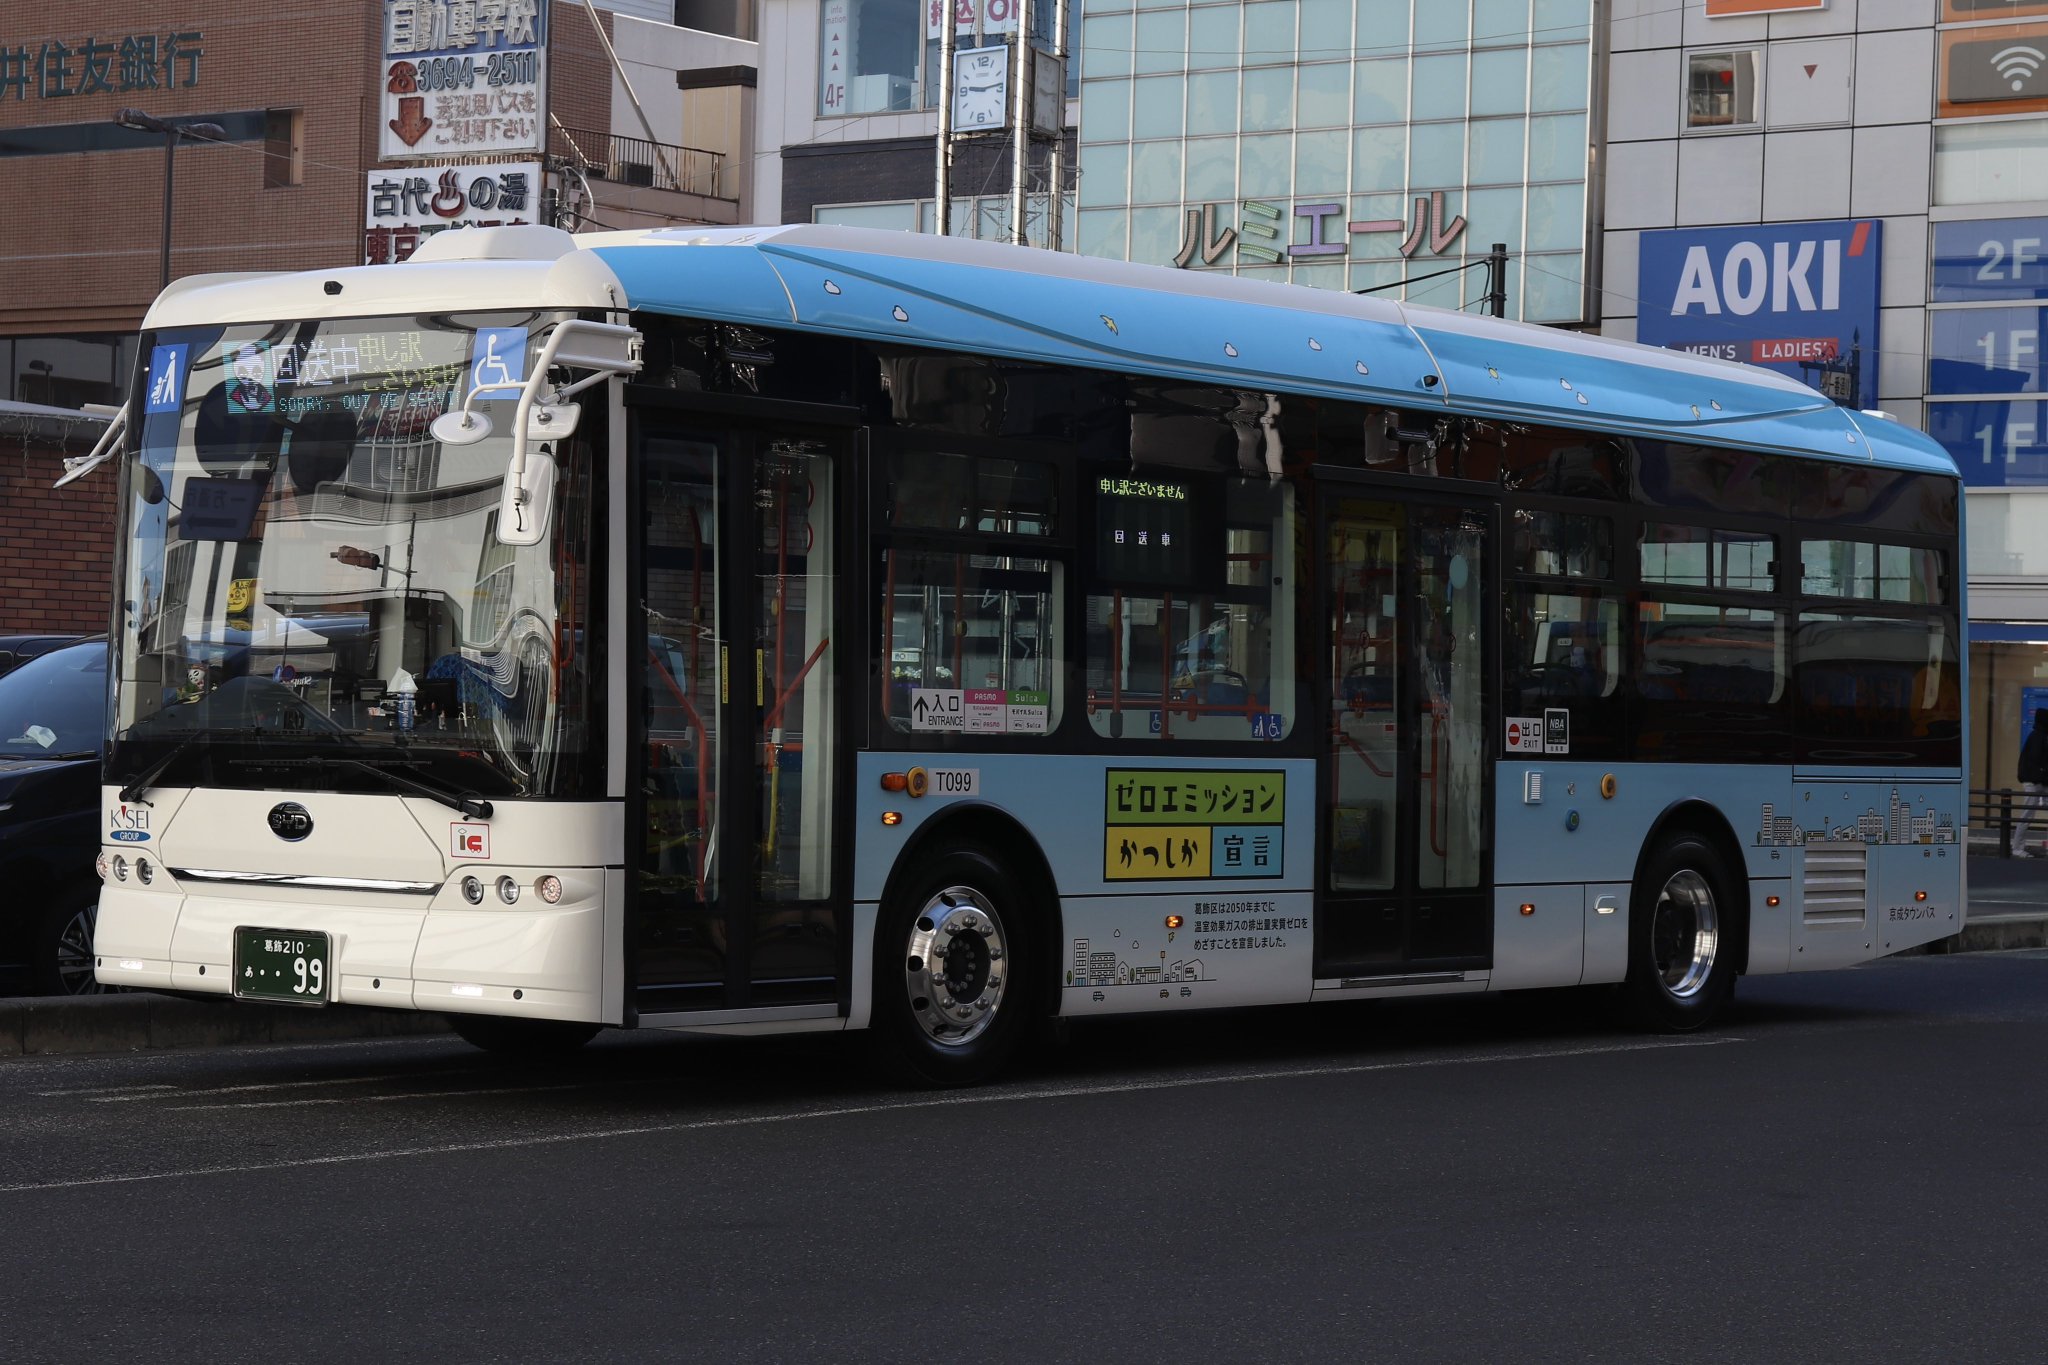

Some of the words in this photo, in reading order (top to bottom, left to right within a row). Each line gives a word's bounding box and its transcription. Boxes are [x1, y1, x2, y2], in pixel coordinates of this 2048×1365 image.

[386, 0, 537, 54] 自動車学校
[0, 31, 204, 100] 井住友銀行
[976, 56, 990, 67] 12
[417, 51, 537, 93] 3694-2511
[825, 83, 844, 108] 4F
[959, 87, 968, 97] 9
[435, 89, 537, 121] 送迎用バスを
[976, 112, 985, 123] 6
[435, 118, 537, 146] ご利用下さい
[371, 177, 432, 217] 古代
[468, 172, 530, 212] の湯
[1173, 191, 1467, 268] ルミエール
[1977, 238, 2041, 281] 2F
[1671, 239, 1841, 316] AOKI
[358, 332, 423, 364] 申し訳
[1761, 341, 1830, 358] LADIES'
[1977, 329, 2038, 371] 1F
[271, 338, 360, 387] 回送中
[342, 393, 369, 410] OUT
[1974, 423, 2036, 465] 1F
[1100, 478, 1184, 500] 申し訳ございません
[932, 694, 959, 712] 入口
[974, 693, 997, 701] PASMO
[1015, 693, 1039, 702] Suica
[928, 715, 963, 727] ENTRANCE
[1521, 721, 1541, 736] 出口
[1549, 718, 1565, 729] NBA
[1523, 739, 1539, 748] EXIT
[936, 772, 972, 792] T099
[1115, 778, 1276, 815] ゼロエミッション
[119, 831, 141, 841] GROUP
[1223, 834, 1271, 867] 宣言
[1194, 901, 1276, 915] 葛飾区は2050年までに
[1889, 906, 1936, 921] 京成タウンバス
[1194, 917, 1308, 933] 温室効果ガスの排出量実質ゼロを
[264, 939, 305, 955] 葛飾210
[1193, 935, 1287, 951] めざすことを宣言しました。
[244, 965, 254, 979] あ
[292, 957, 323, 995] 99
